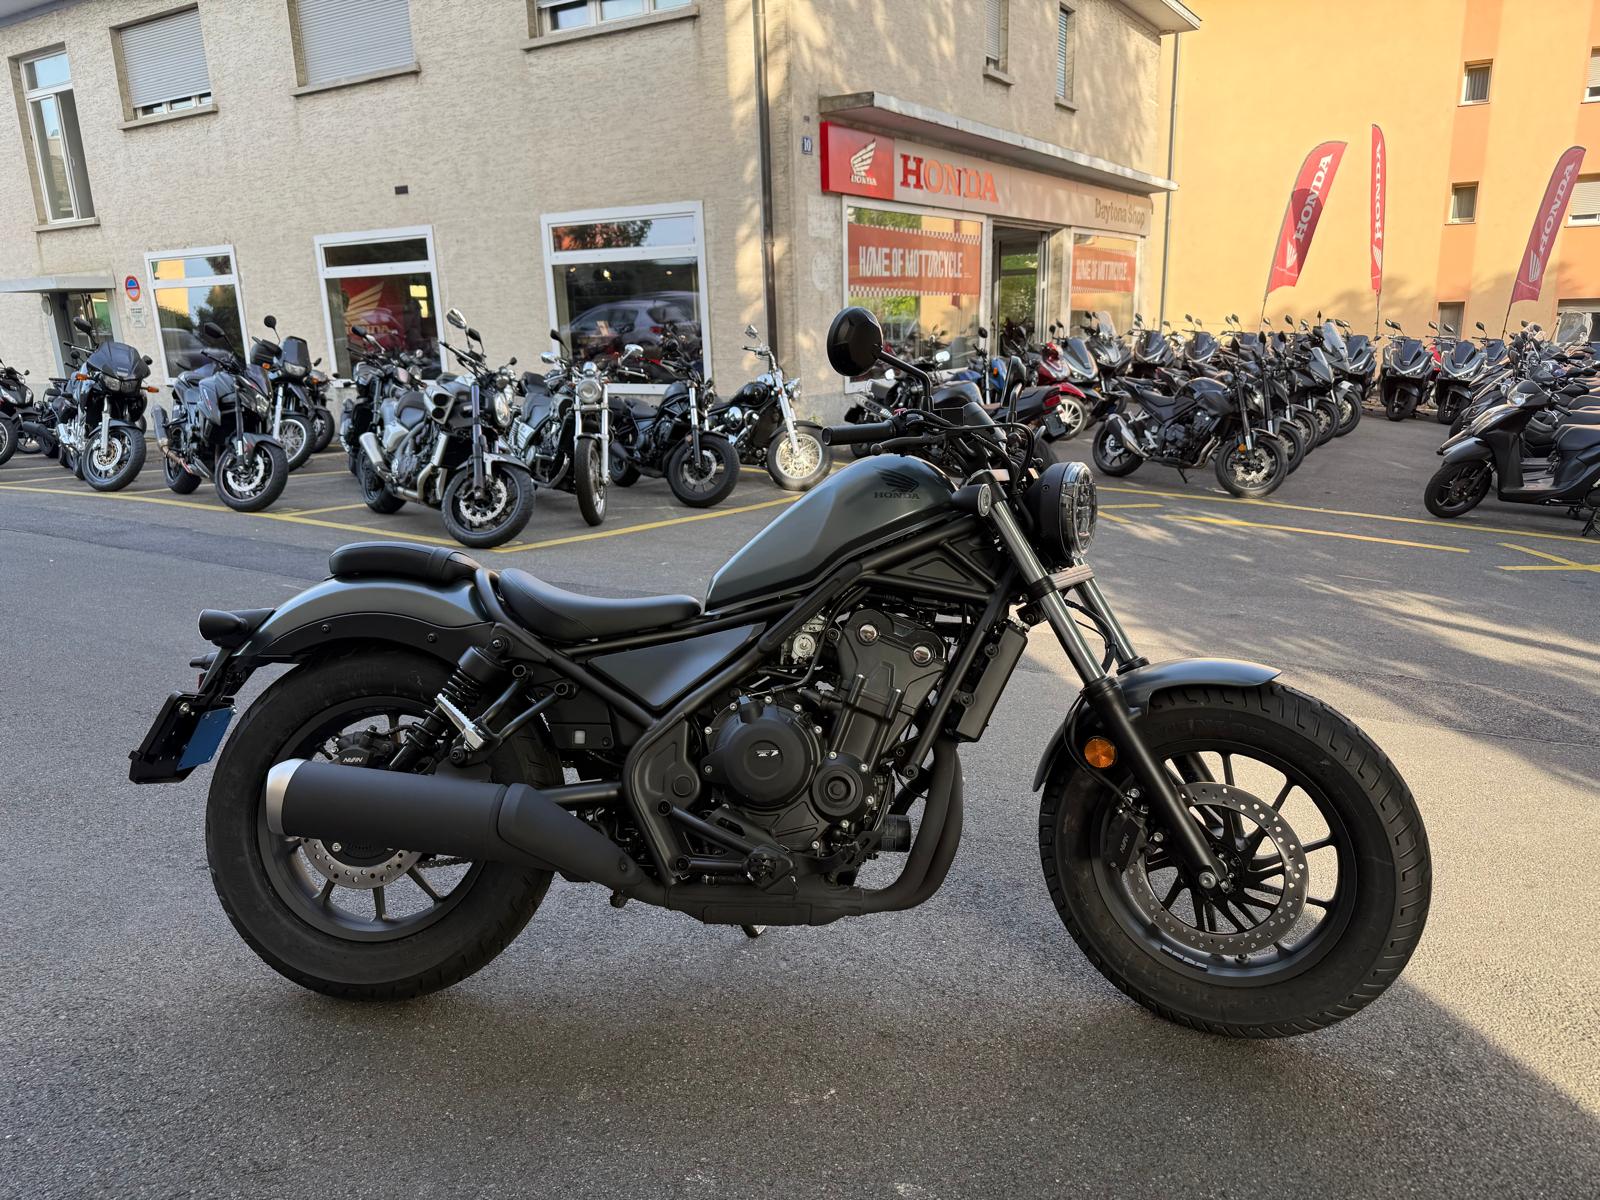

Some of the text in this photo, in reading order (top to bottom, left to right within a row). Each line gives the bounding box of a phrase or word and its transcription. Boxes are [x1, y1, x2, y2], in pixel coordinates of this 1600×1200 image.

[851, 174, 878, 186] HONDA
[900, 153, 1000, 203] HONDA
[1293, 153, 1334, 242] HONDA
[1374, 141, 1382, 241] HONDA
[1095, 198, 1145, 230] Daytona Shop
[1539, 162, 1576, 256] HONDA
[892, 248, 904, 277] OF
[874, 491, 920, 500] HONDA
